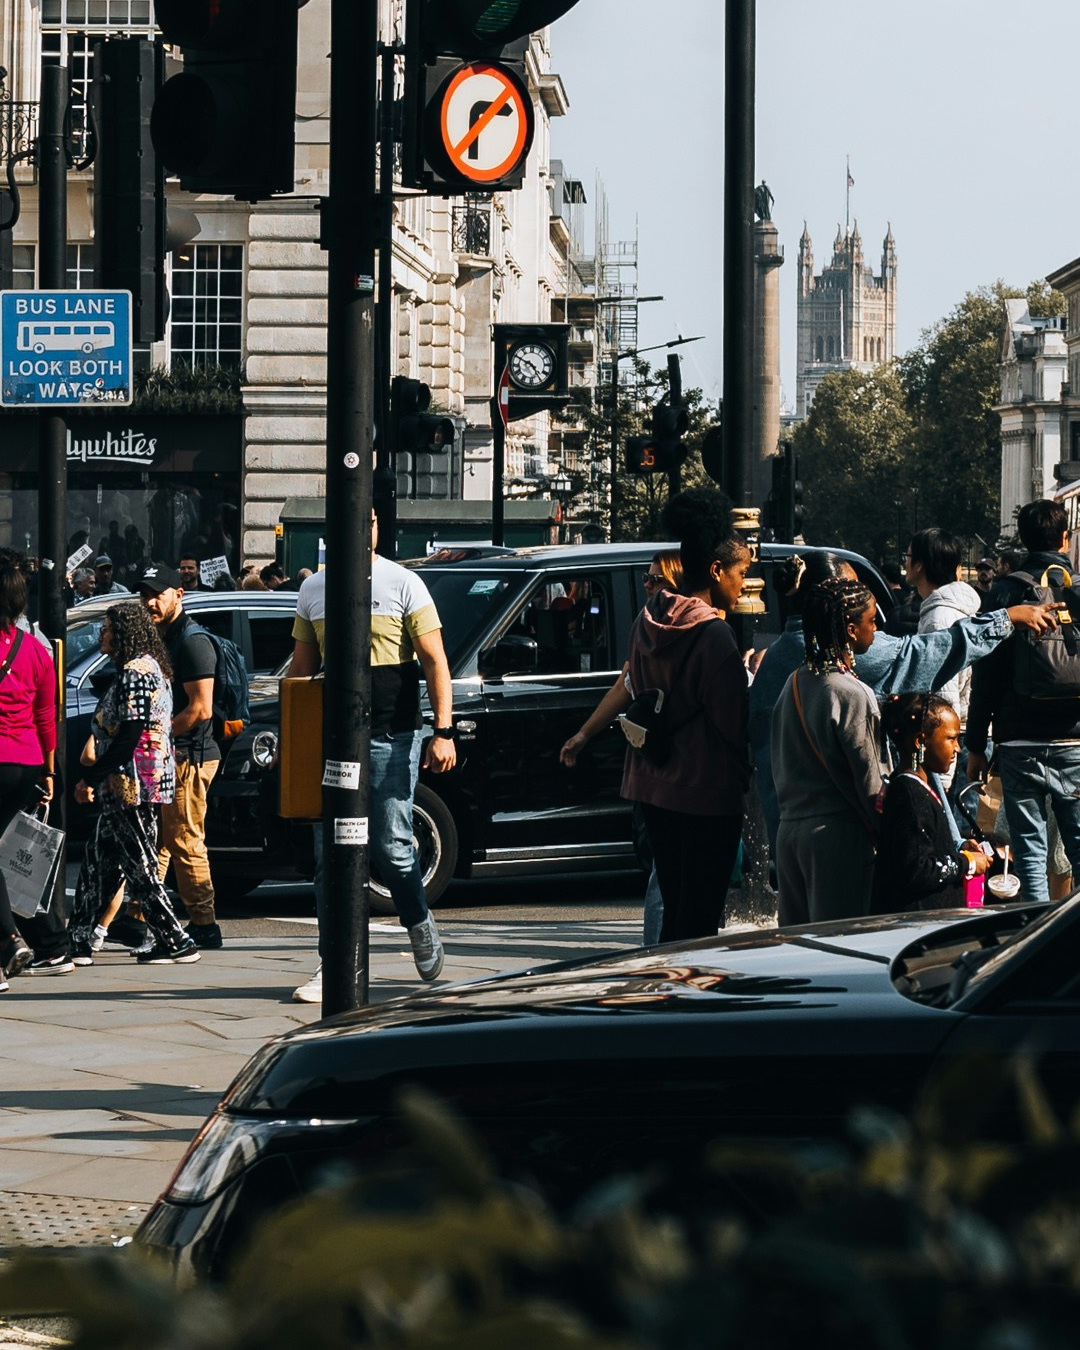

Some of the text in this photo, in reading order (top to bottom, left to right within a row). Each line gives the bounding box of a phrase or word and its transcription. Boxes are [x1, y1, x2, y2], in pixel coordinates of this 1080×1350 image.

[16, 299, 115, 314] BUS LANE
[10, 360, 123, 376] LOOK BOTH
[39, 383, 94, 398] WAYS
[66, 429, 157, 464] lywhites
[326, 769, 352, 778] TERROR
